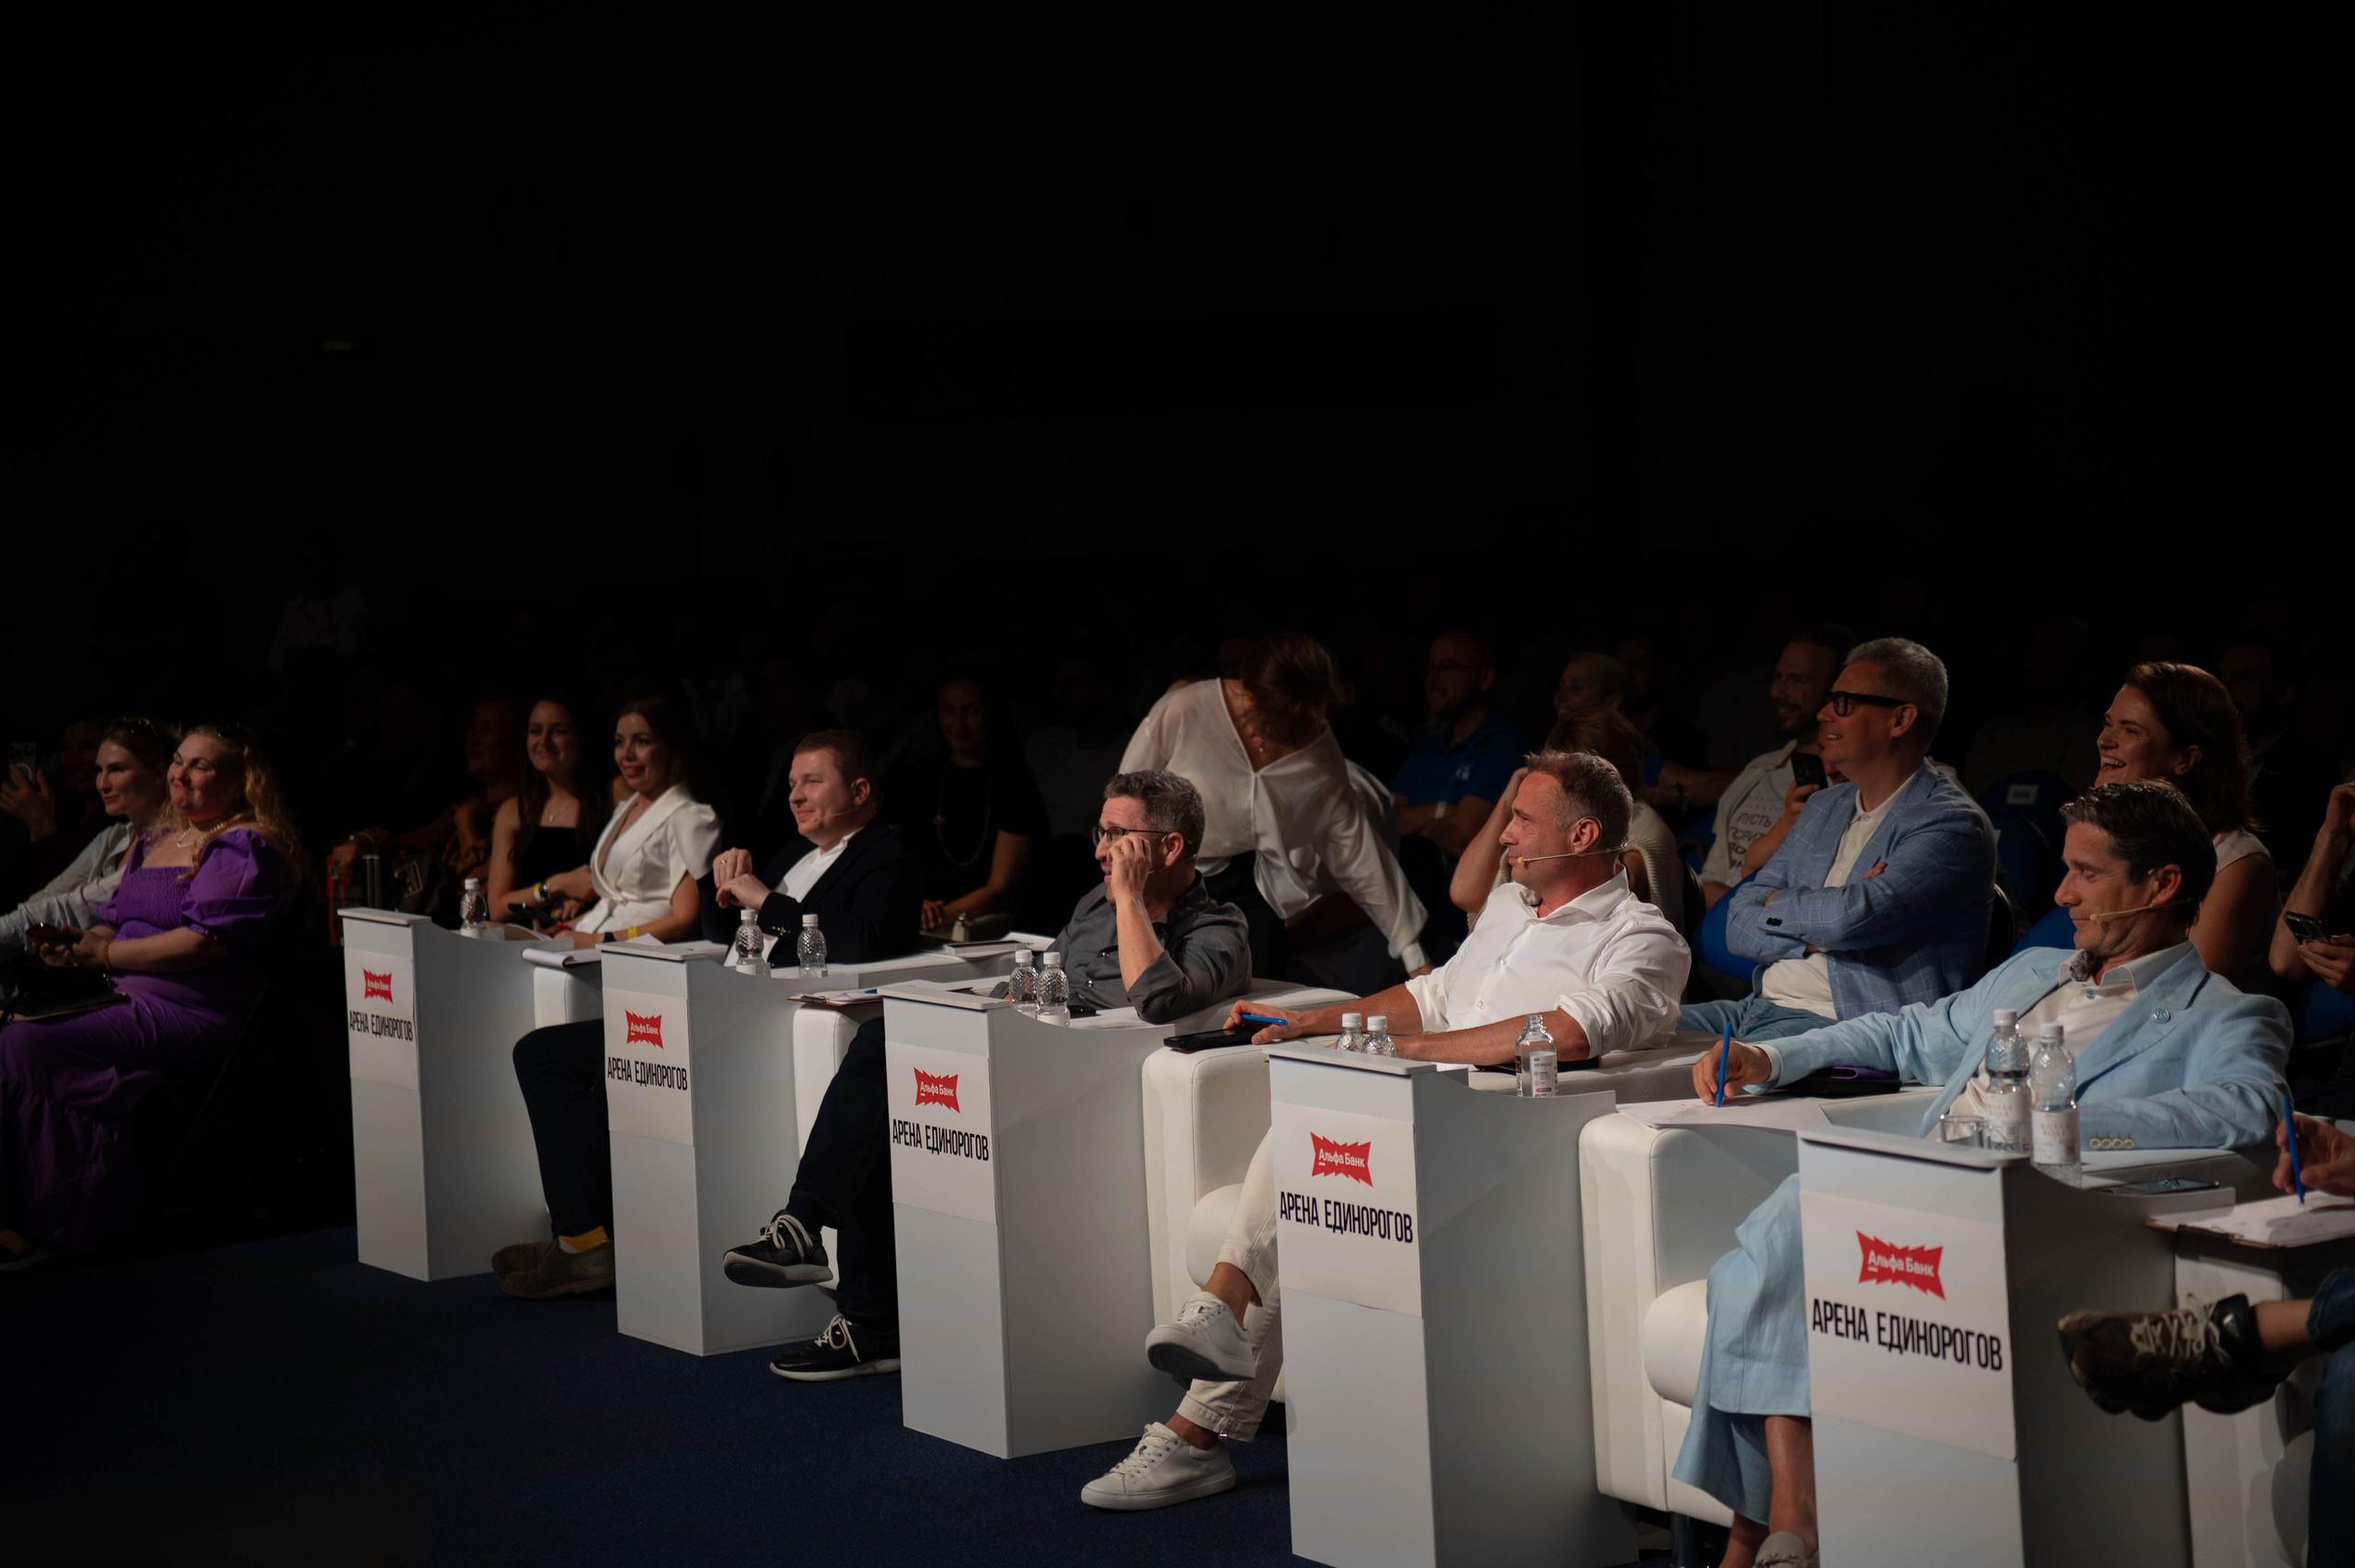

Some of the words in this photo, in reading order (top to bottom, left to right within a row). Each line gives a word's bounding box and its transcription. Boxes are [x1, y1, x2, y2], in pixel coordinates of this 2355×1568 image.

[1737, 812, 1772, 828] ПУСТЬ
[350, 1011, 369, 1033] АРЕНА
[371, 1014, 413, 1041] ЕДИНОРОГОВ
[630, 1022, 646, 1036] Альфа
[646, 1024, 660, 1036] Банк
[608, 1057, 632, 1082] АРЕНА
[635, 1060, 687, 1091] ЕДИНОРОГОВ
[920, 1082, 938, 1096] Альфа
[939, 1084, 955, 1097] Банк
[892, 1118, 923, 1149] АРЕНА
[925, 1125, 989, 1162] ЕДИНОРОГОВ
[1318, 1149, 1344, 1166] Альфа
[1344, 1152, 1365, 1168] Банк
[1281, 1191, 1320, 1227] АРЕНА
[1324, 1199, 1413, 1243] ЕДИНОРОГОВ
[1867, 1250, 1904, 1274] Альфа
[1905, 1257, 1935, 1277] Банк
[1812, 1299, 1869, 1344] АРЕНА
[1877, 1311, 2003, 1371] ЕДИНОРОГОВ
